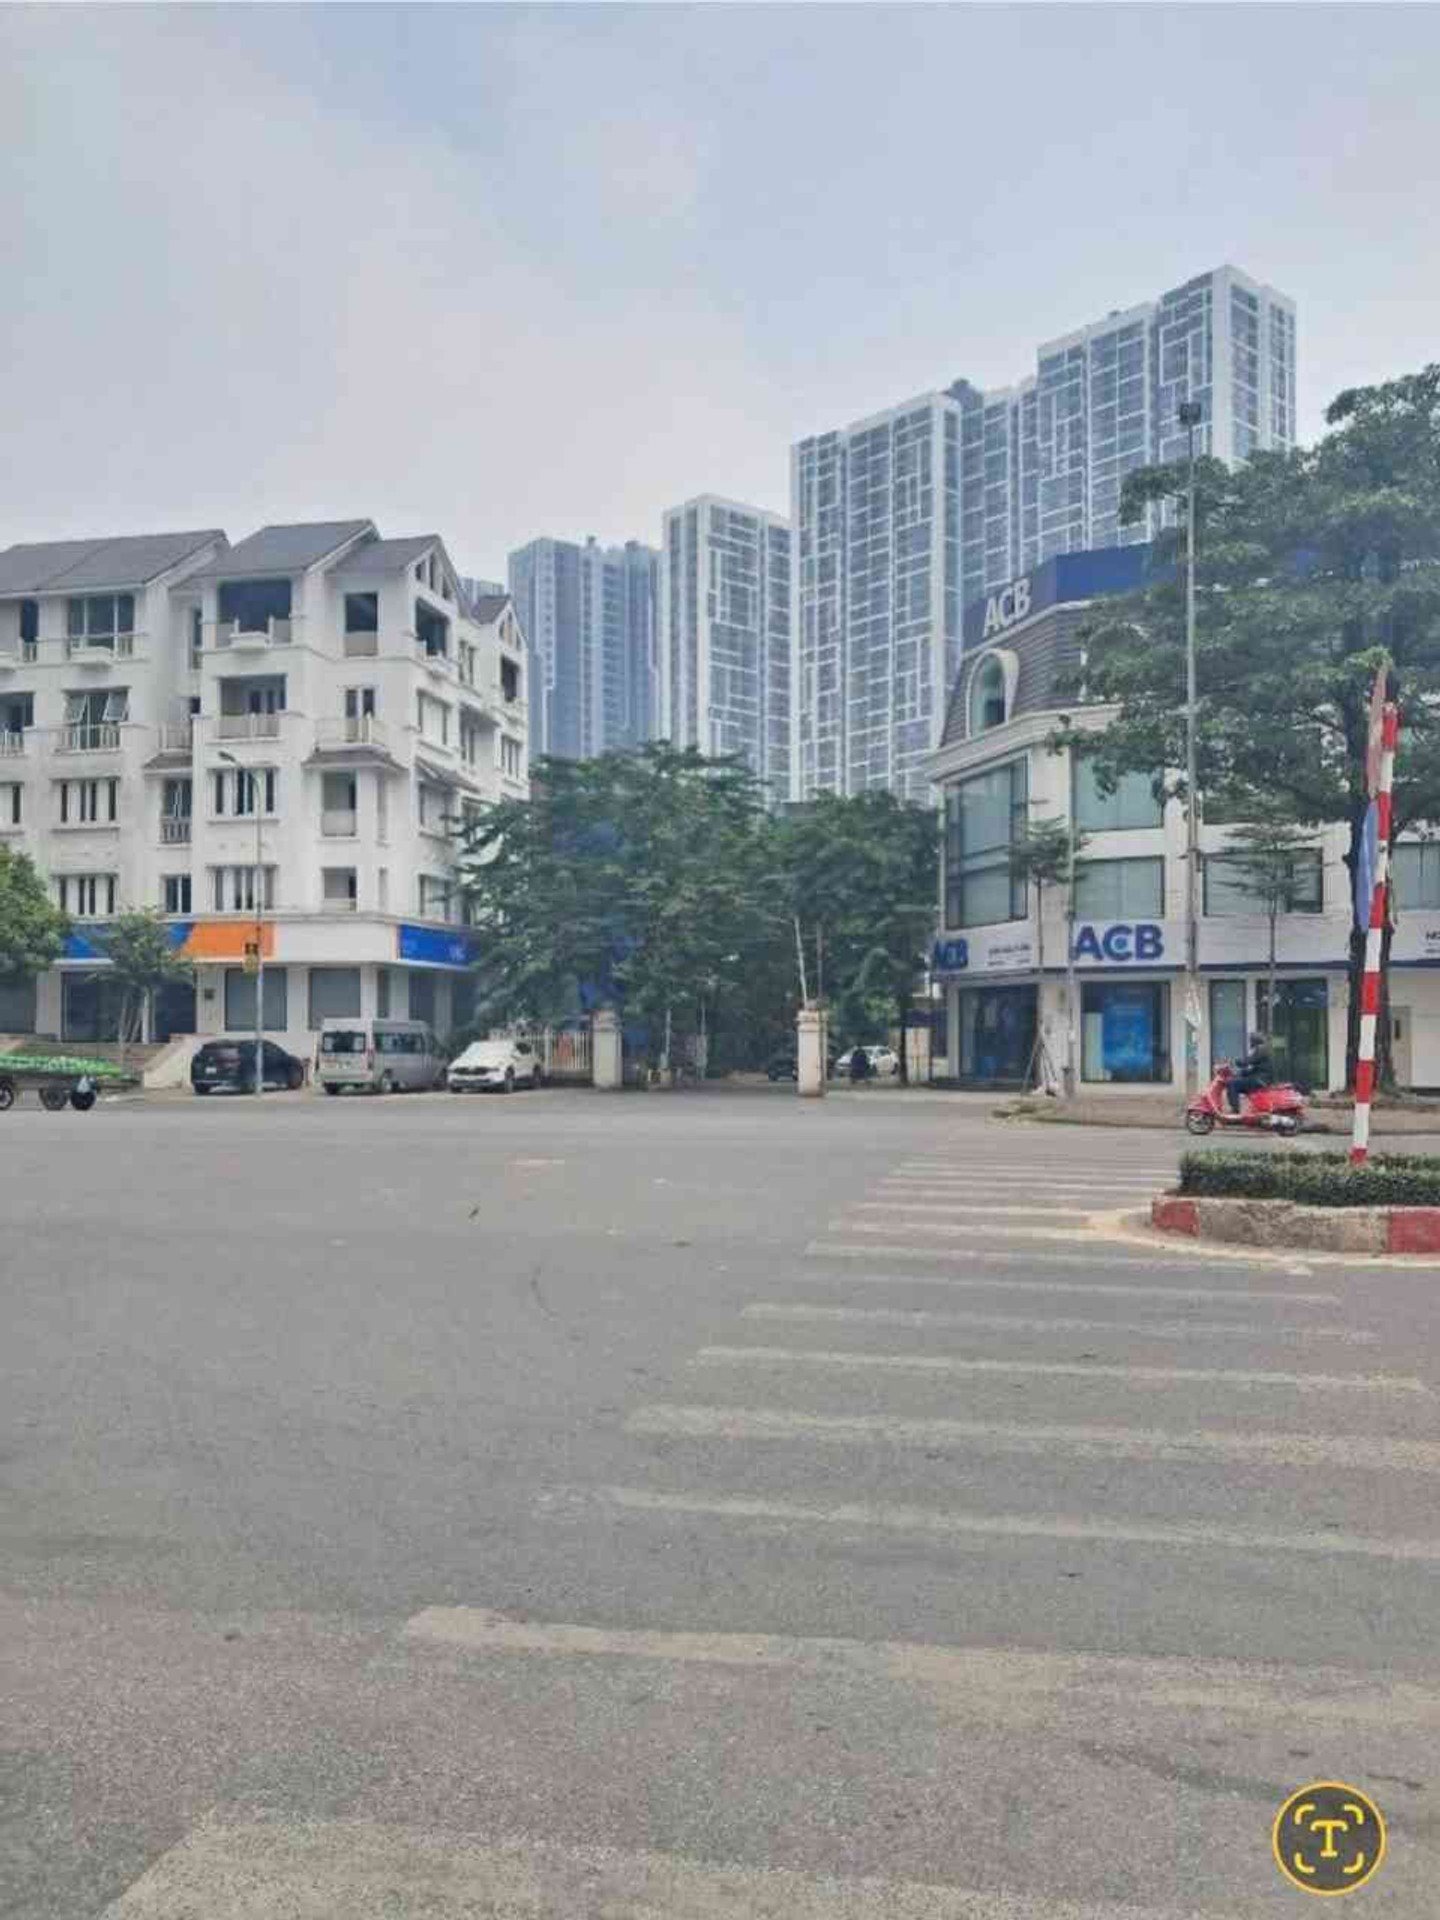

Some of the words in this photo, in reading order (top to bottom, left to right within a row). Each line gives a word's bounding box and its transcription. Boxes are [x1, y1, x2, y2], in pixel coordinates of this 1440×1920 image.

[983, 579, 1031, 637] ACB
[934, 939, 968, 970] ACB
[1072, 923, 1165, 961] ACB
